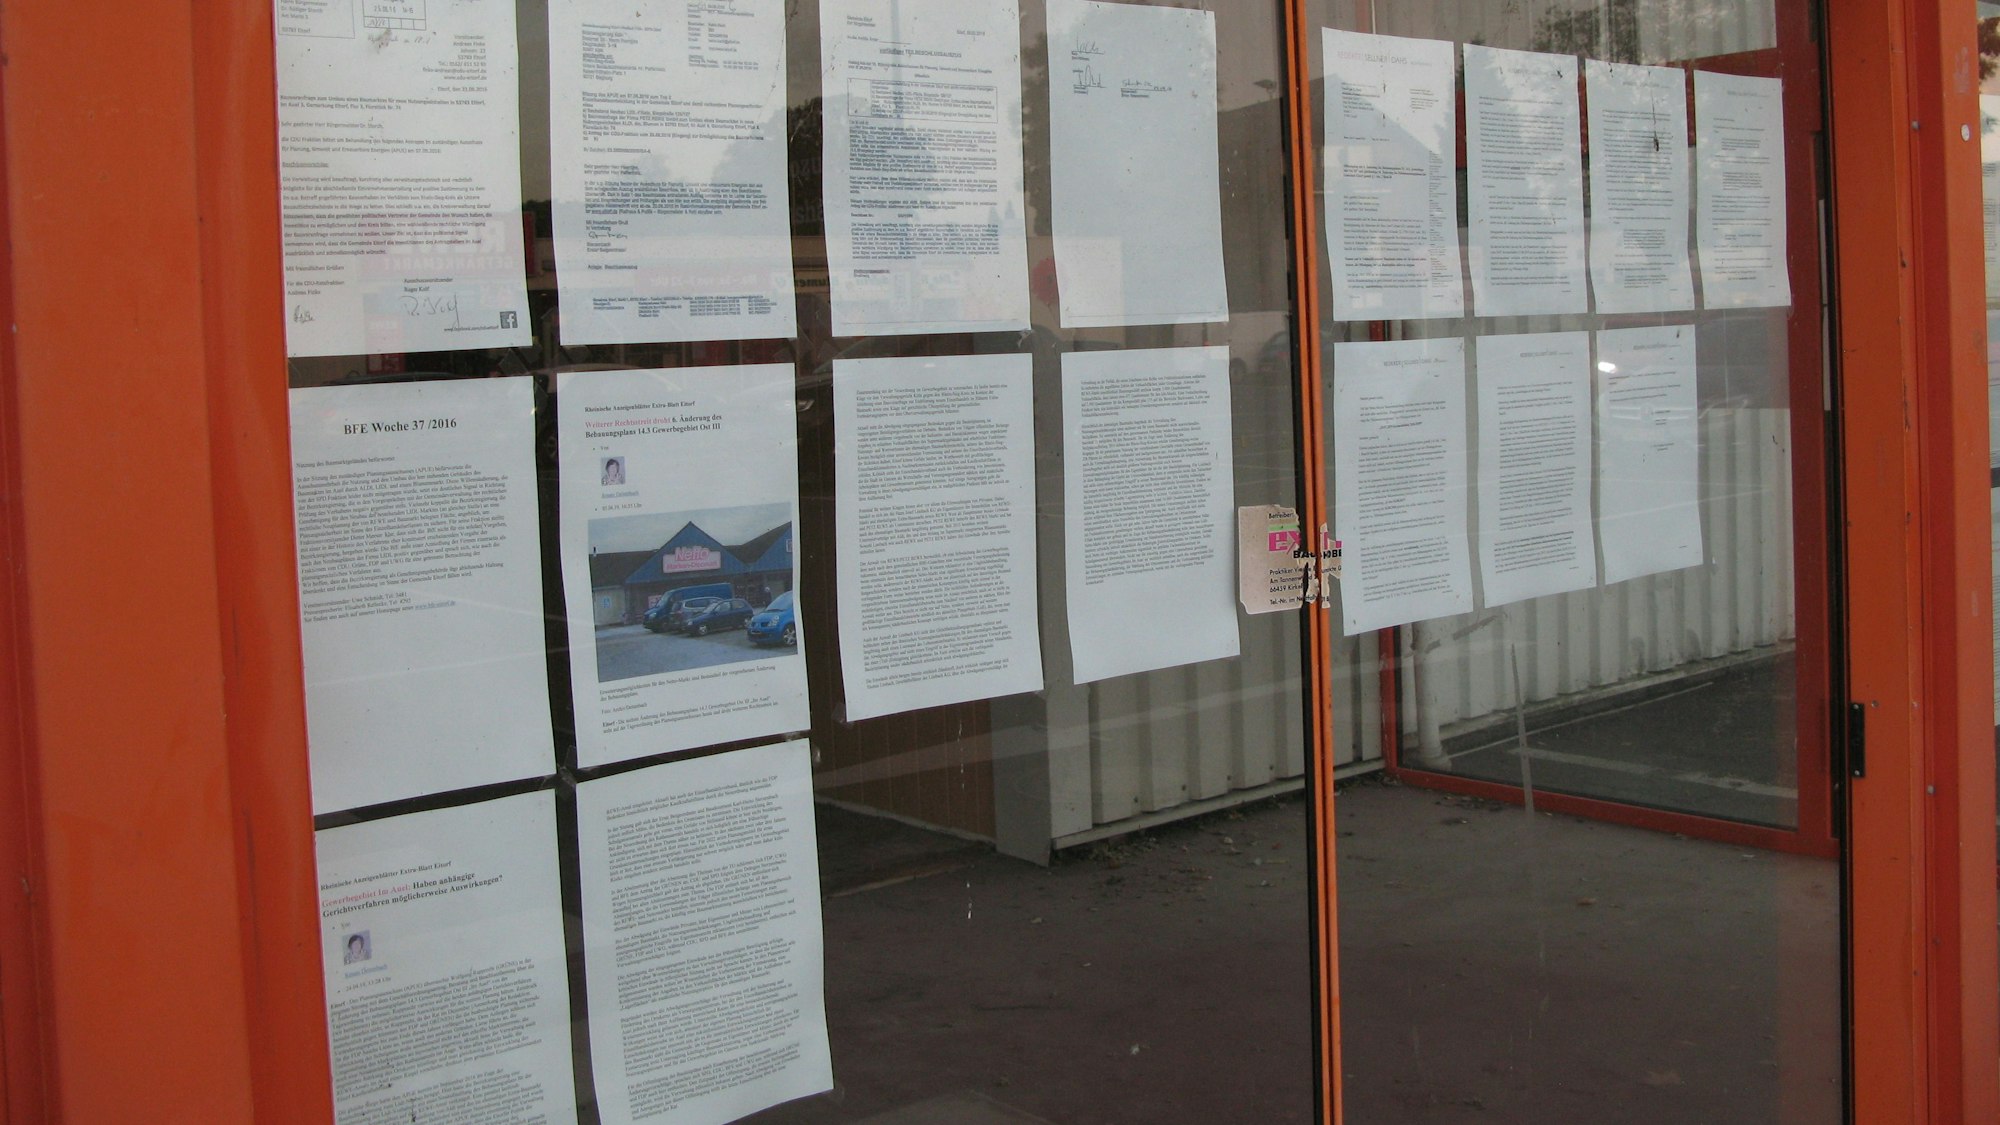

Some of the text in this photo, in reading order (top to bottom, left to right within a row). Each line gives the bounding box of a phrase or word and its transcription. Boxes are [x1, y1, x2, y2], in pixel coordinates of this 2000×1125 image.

[344, 418, 457, 435] BFE Woche 37 /2016
[585, 420, 613, 429] Weiterer
[614, 417, 652, 427] Rechtsstreit
[680, 414, 711, 423] Änderung
[585, 428, 637, 439] Bebauungsplans
[652, 424, 699, 434] Gewerbegebiet
[700, 423, 711, 431] Ost
[675, 546, 710, 561] Netto
[1269, 568, 1293, 576] Praktiker
[321, 880, 352, 891] Rheinische
[353, 870, 398, 885] Anzeigenblätter
[322, 891, 377, 907] Gewerbegebiet
[413, 879, 437, 890] Haben
[439, 871, 476, 885] anhängige
[323, 874, 503, 918] Gerichtsverfahren möglicherweise Auswirkungen?
